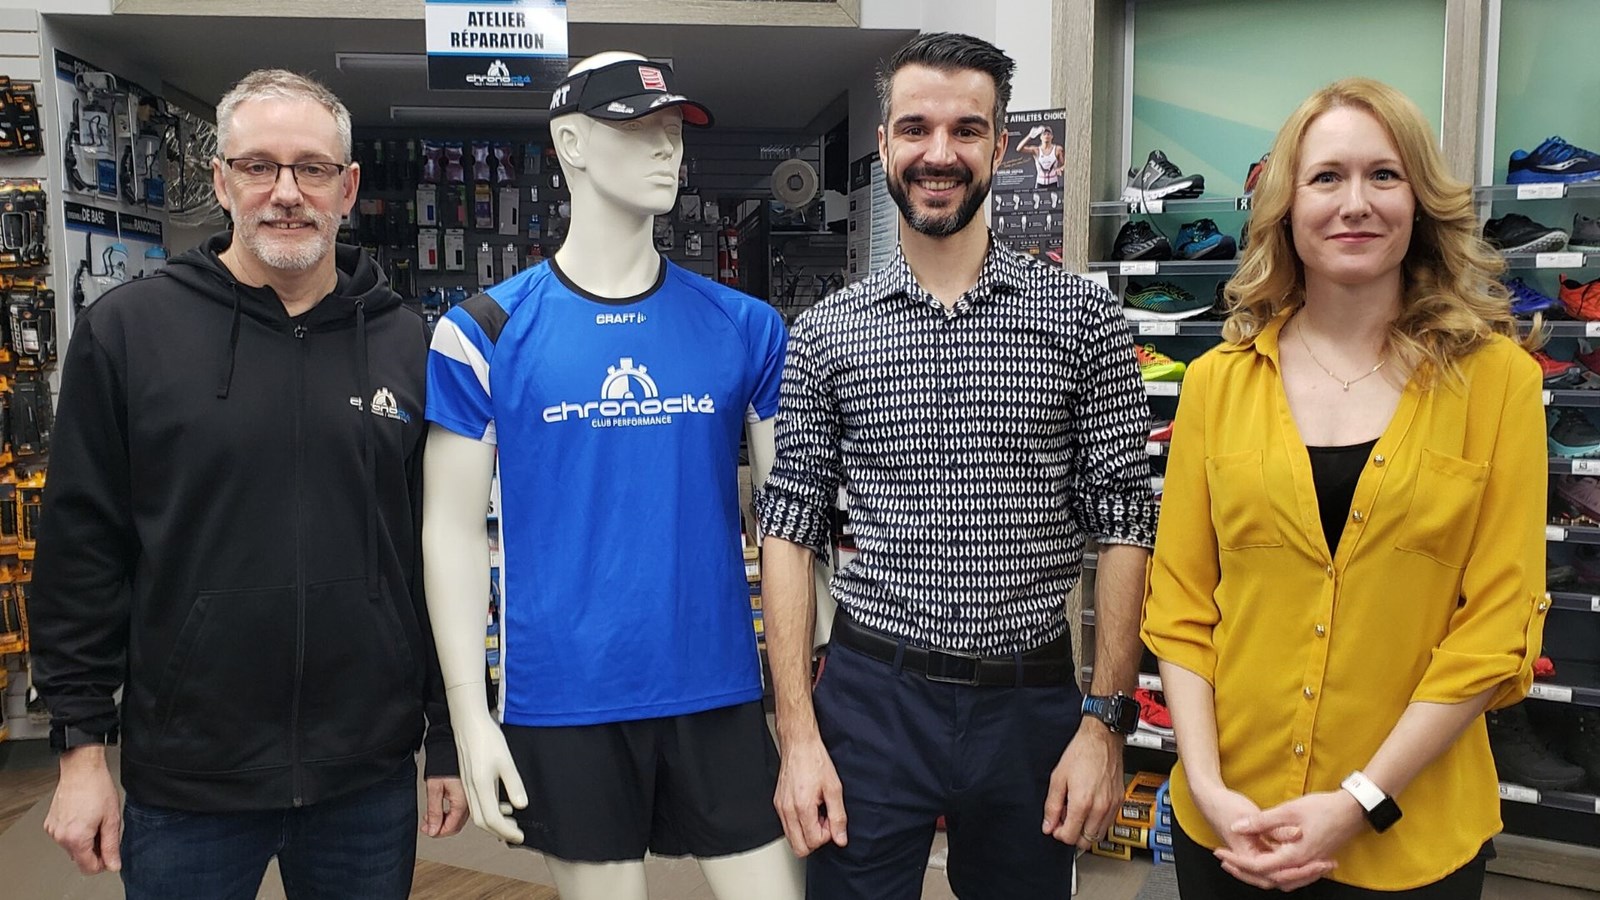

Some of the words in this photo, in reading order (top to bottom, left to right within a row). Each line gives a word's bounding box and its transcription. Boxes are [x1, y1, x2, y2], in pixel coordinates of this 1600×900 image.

[467, 11, 526, 28] ATELIER
[450, 29, 545, 49] RÉPARATION
[1010, 112, 1042, 123] ATHLETES
[81, 208, 91, 222] DE
[91, 210, 105, 225] BASE
[596, 314, 636, 325] CRAFT
[542, 393, 715, 423] chronocité
[591, 418, 611, 428] CLUB
[612, 415, 672, 427] PERFORMANCE
